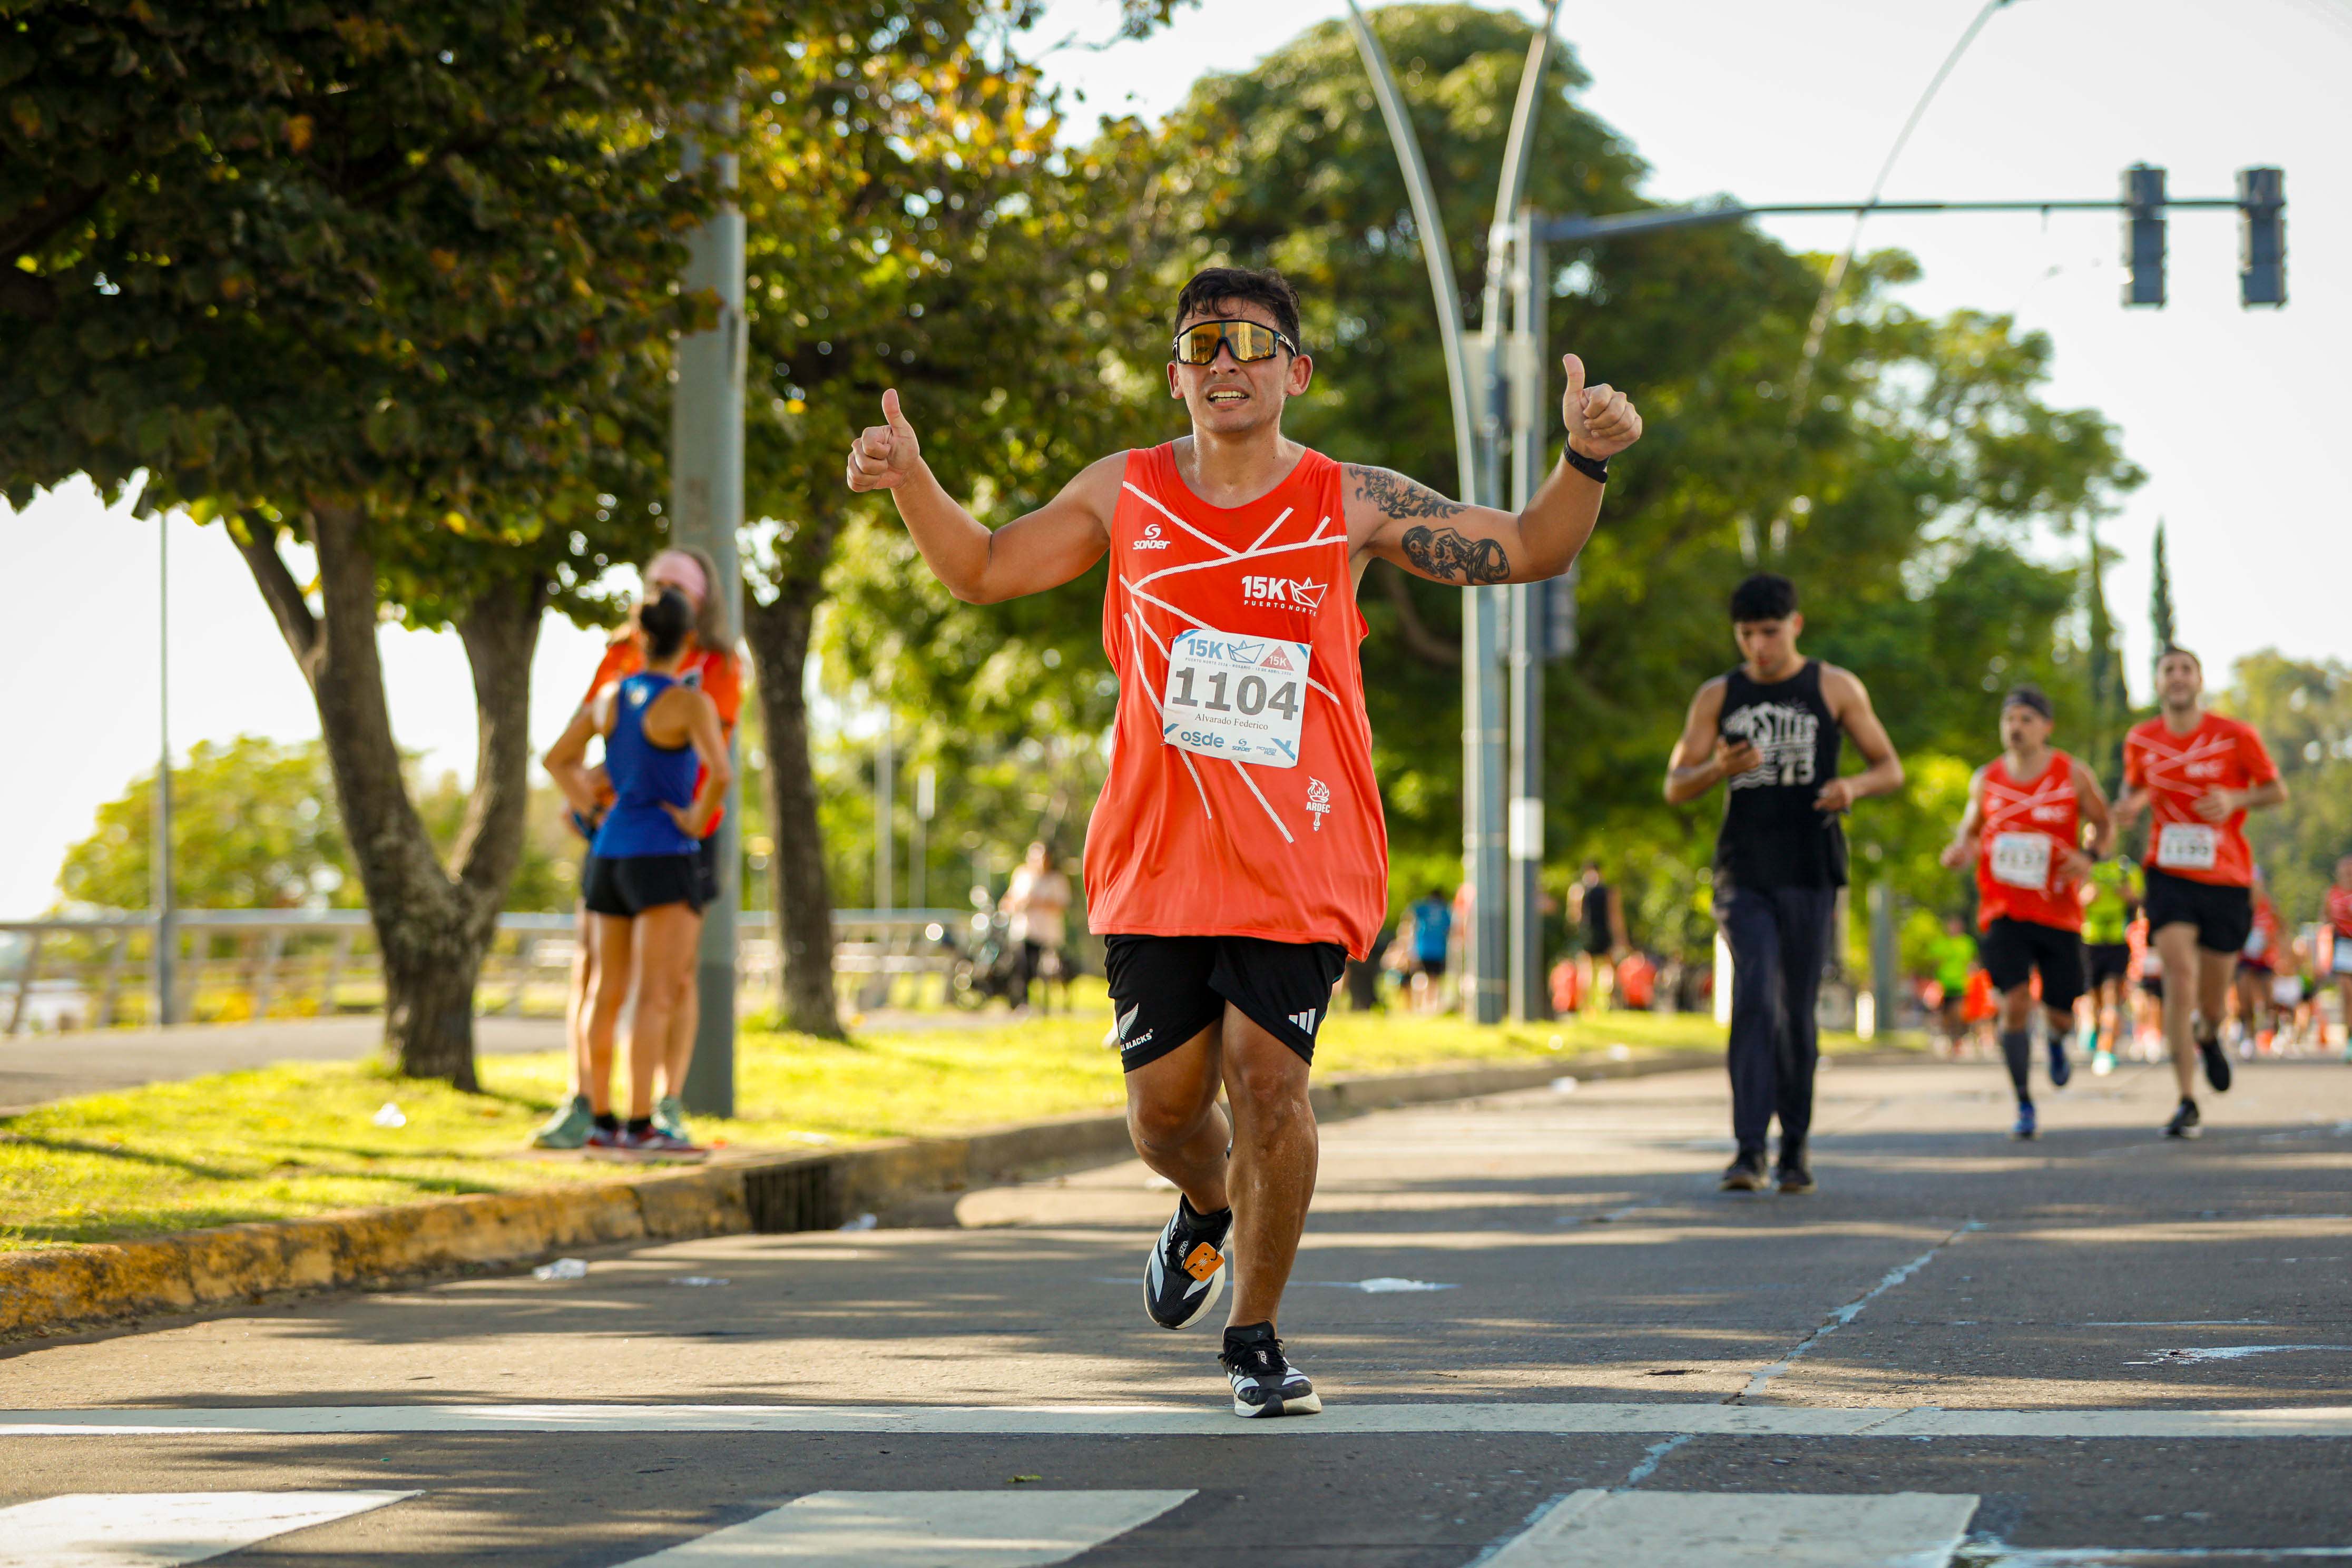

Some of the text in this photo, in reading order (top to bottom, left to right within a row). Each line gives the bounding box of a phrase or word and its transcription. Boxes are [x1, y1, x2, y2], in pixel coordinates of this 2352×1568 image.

[1241, 575, 1288, 601] 15K
[1188, 638, 1223, 660] 15K
[1269, 655, 1287, 667] 15K
[1172, 667, 1299, 720] 1104
[1195, 713, 1269, 730] Alvarado Federico
[1181, 731, 1224, 748] osde
[1306, 801, 1330, 814] ARDEC
